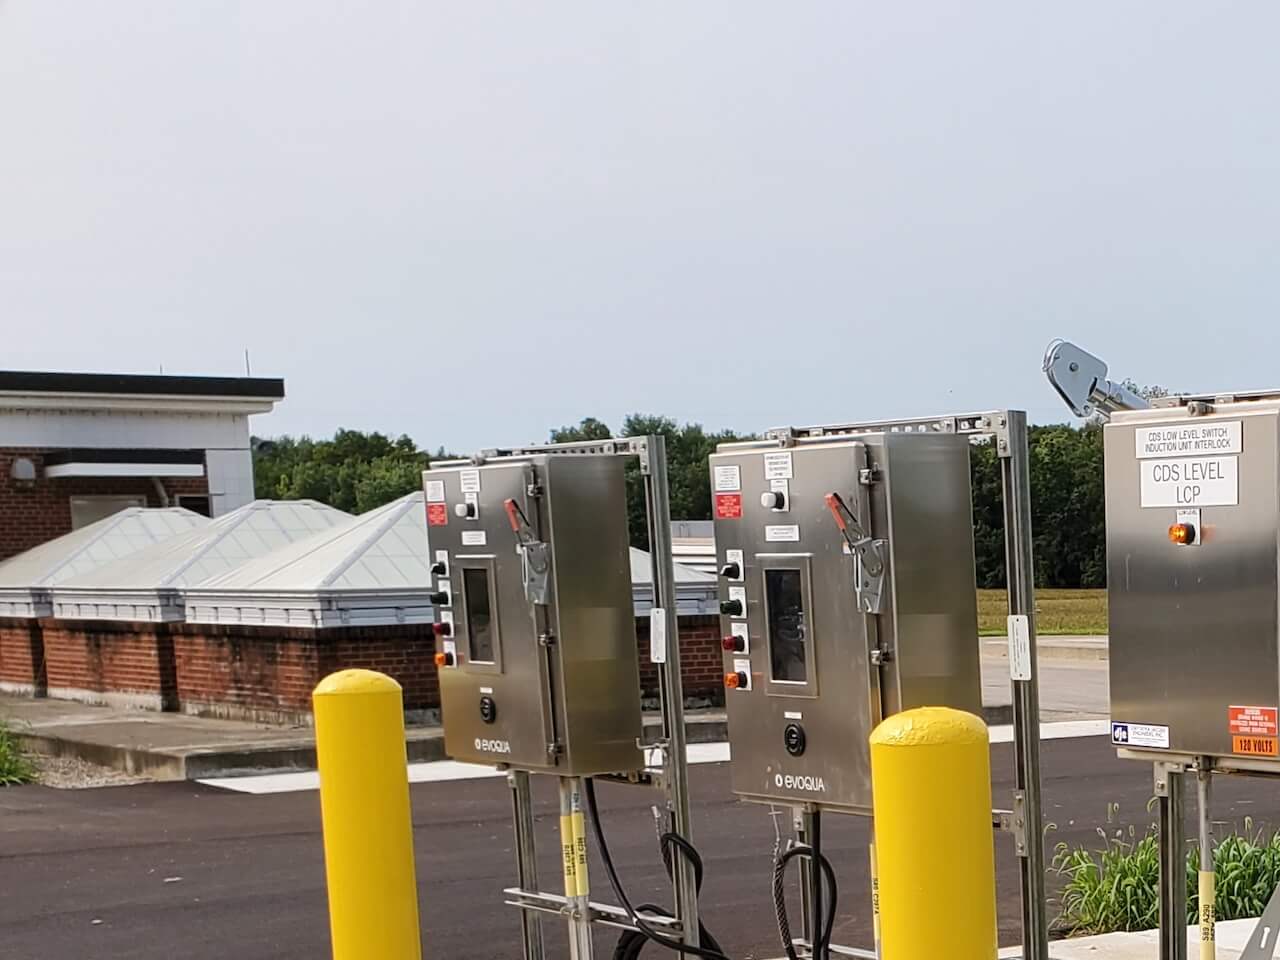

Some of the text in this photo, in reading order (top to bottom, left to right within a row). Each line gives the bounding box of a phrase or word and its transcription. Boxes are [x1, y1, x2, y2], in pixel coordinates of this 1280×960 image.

[1148, 428, 1228, 442] CDS LOW LEVEL SWITCH
[1145, 438, 1231, 453] INDUCTION UNIT INTERLOCK
[1153, 461, 1224, 482] CDS LEVEL
[1176, 485, 1201, 504] LCP
[1240, 739, 1273, 753] 120 VOLTS
